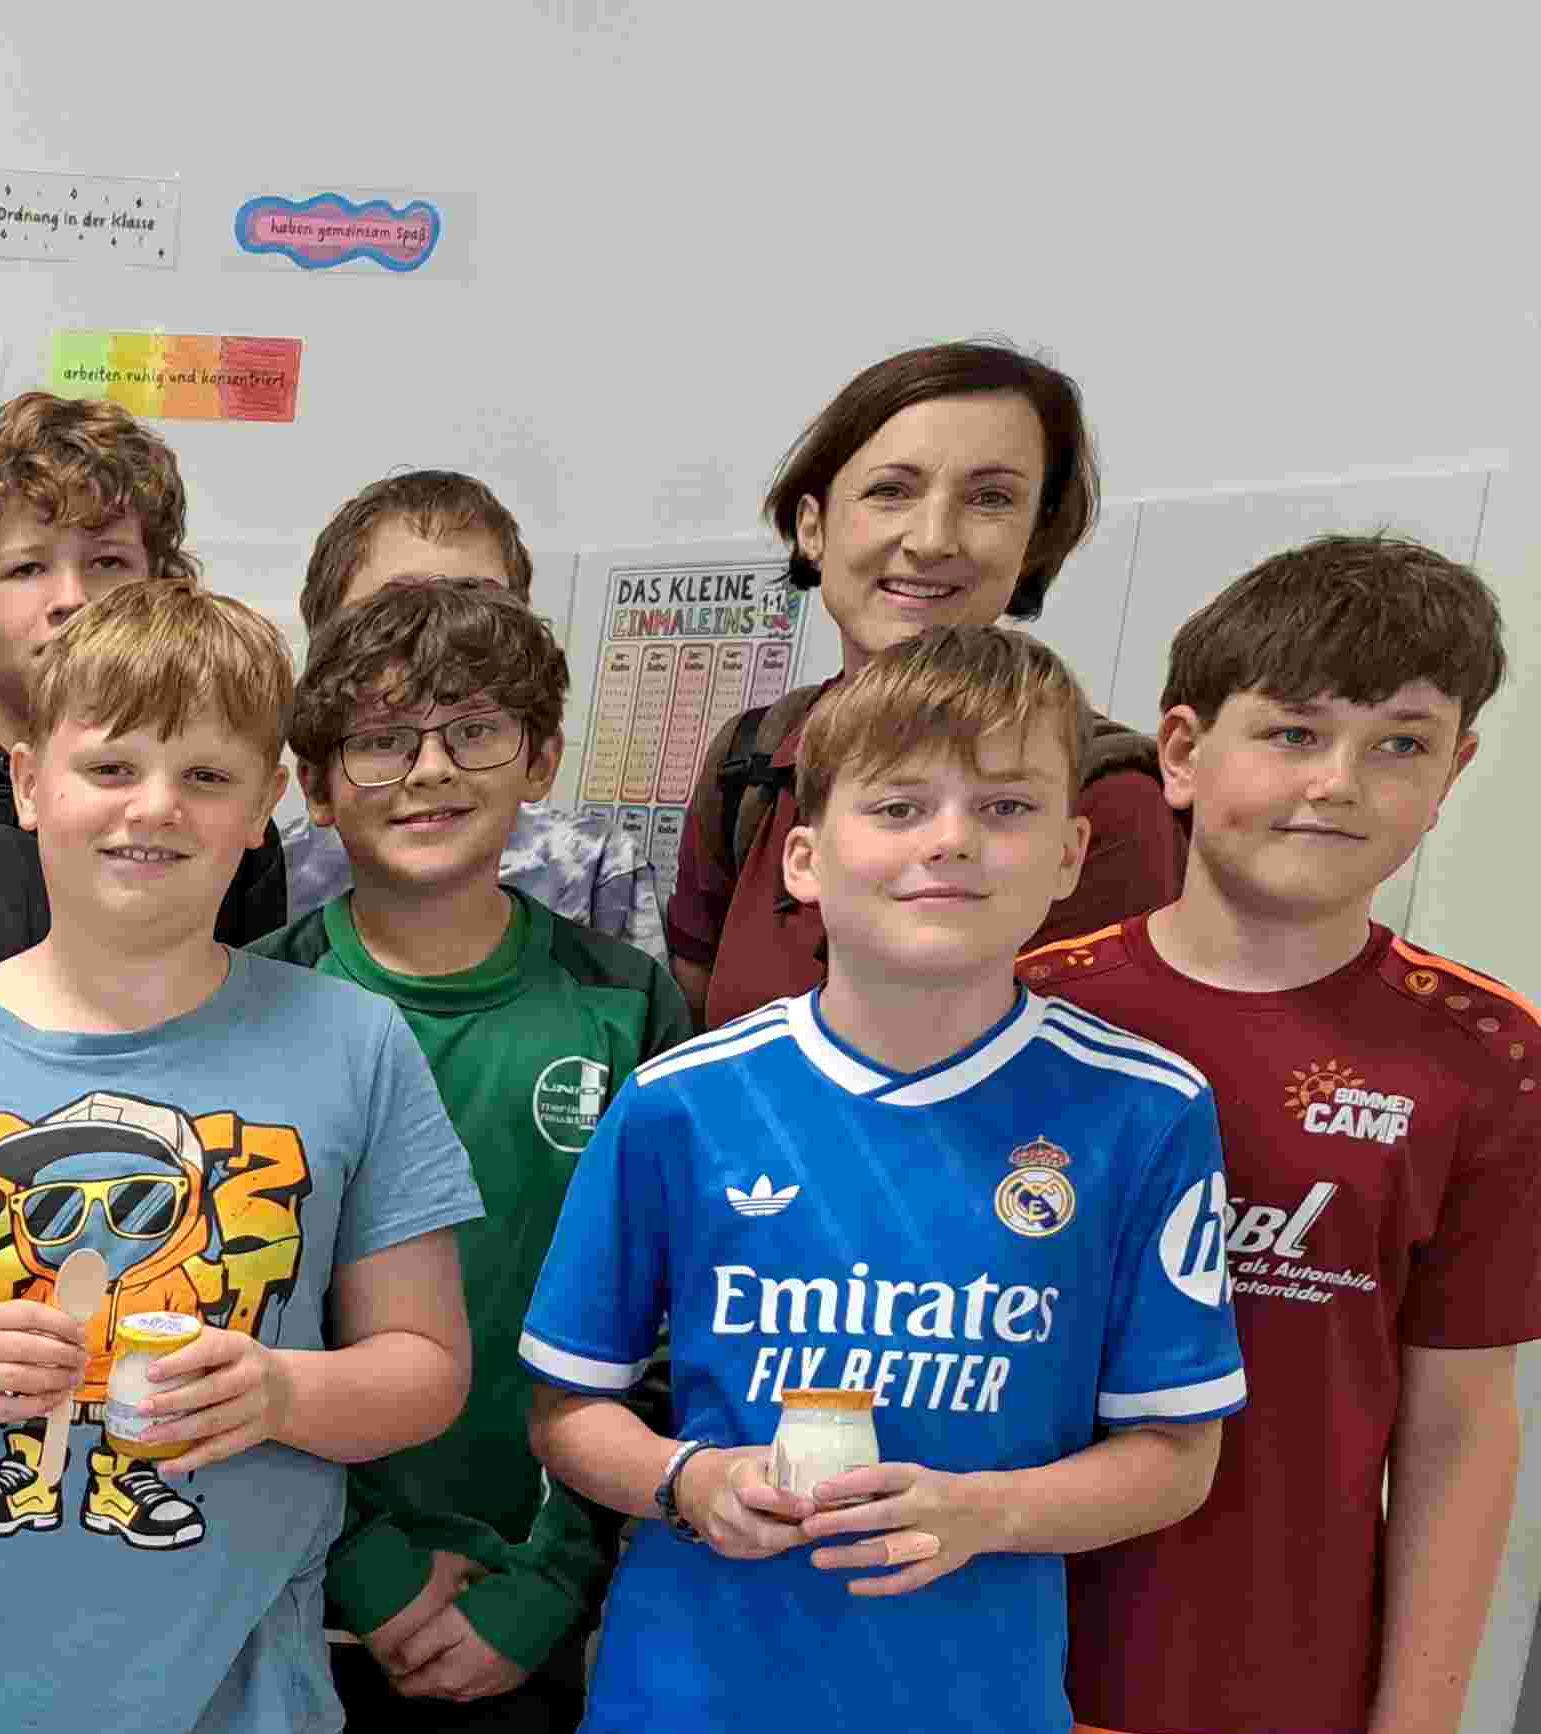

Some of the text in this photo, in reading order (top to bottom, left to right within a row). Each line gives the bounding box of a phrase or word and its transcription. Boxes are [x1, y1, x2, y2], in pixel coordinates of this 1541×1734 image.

[64, 210, 78, 225] in
[83, 211, 107, 227] der
[270, 217, 313, 234] haben
[317, 226, 390, 241] gemeinsam
[64, 364, 285, 389] arbeiten ruhig und konzentriert
[617, 574, 755, 604] DAS KLEINE
[612, 605, 756, 638] EINMALEINS
[1334, 1087, 1415, 1117] SOMMER
[1303, 1103, 1409, 1145] CAMP
[1237, 1257, 1378, 1293] als Automobile
[712, 1262, 1060, 1343] Emirates
[746, 1346, 1011, 1413] FLY BETTER
